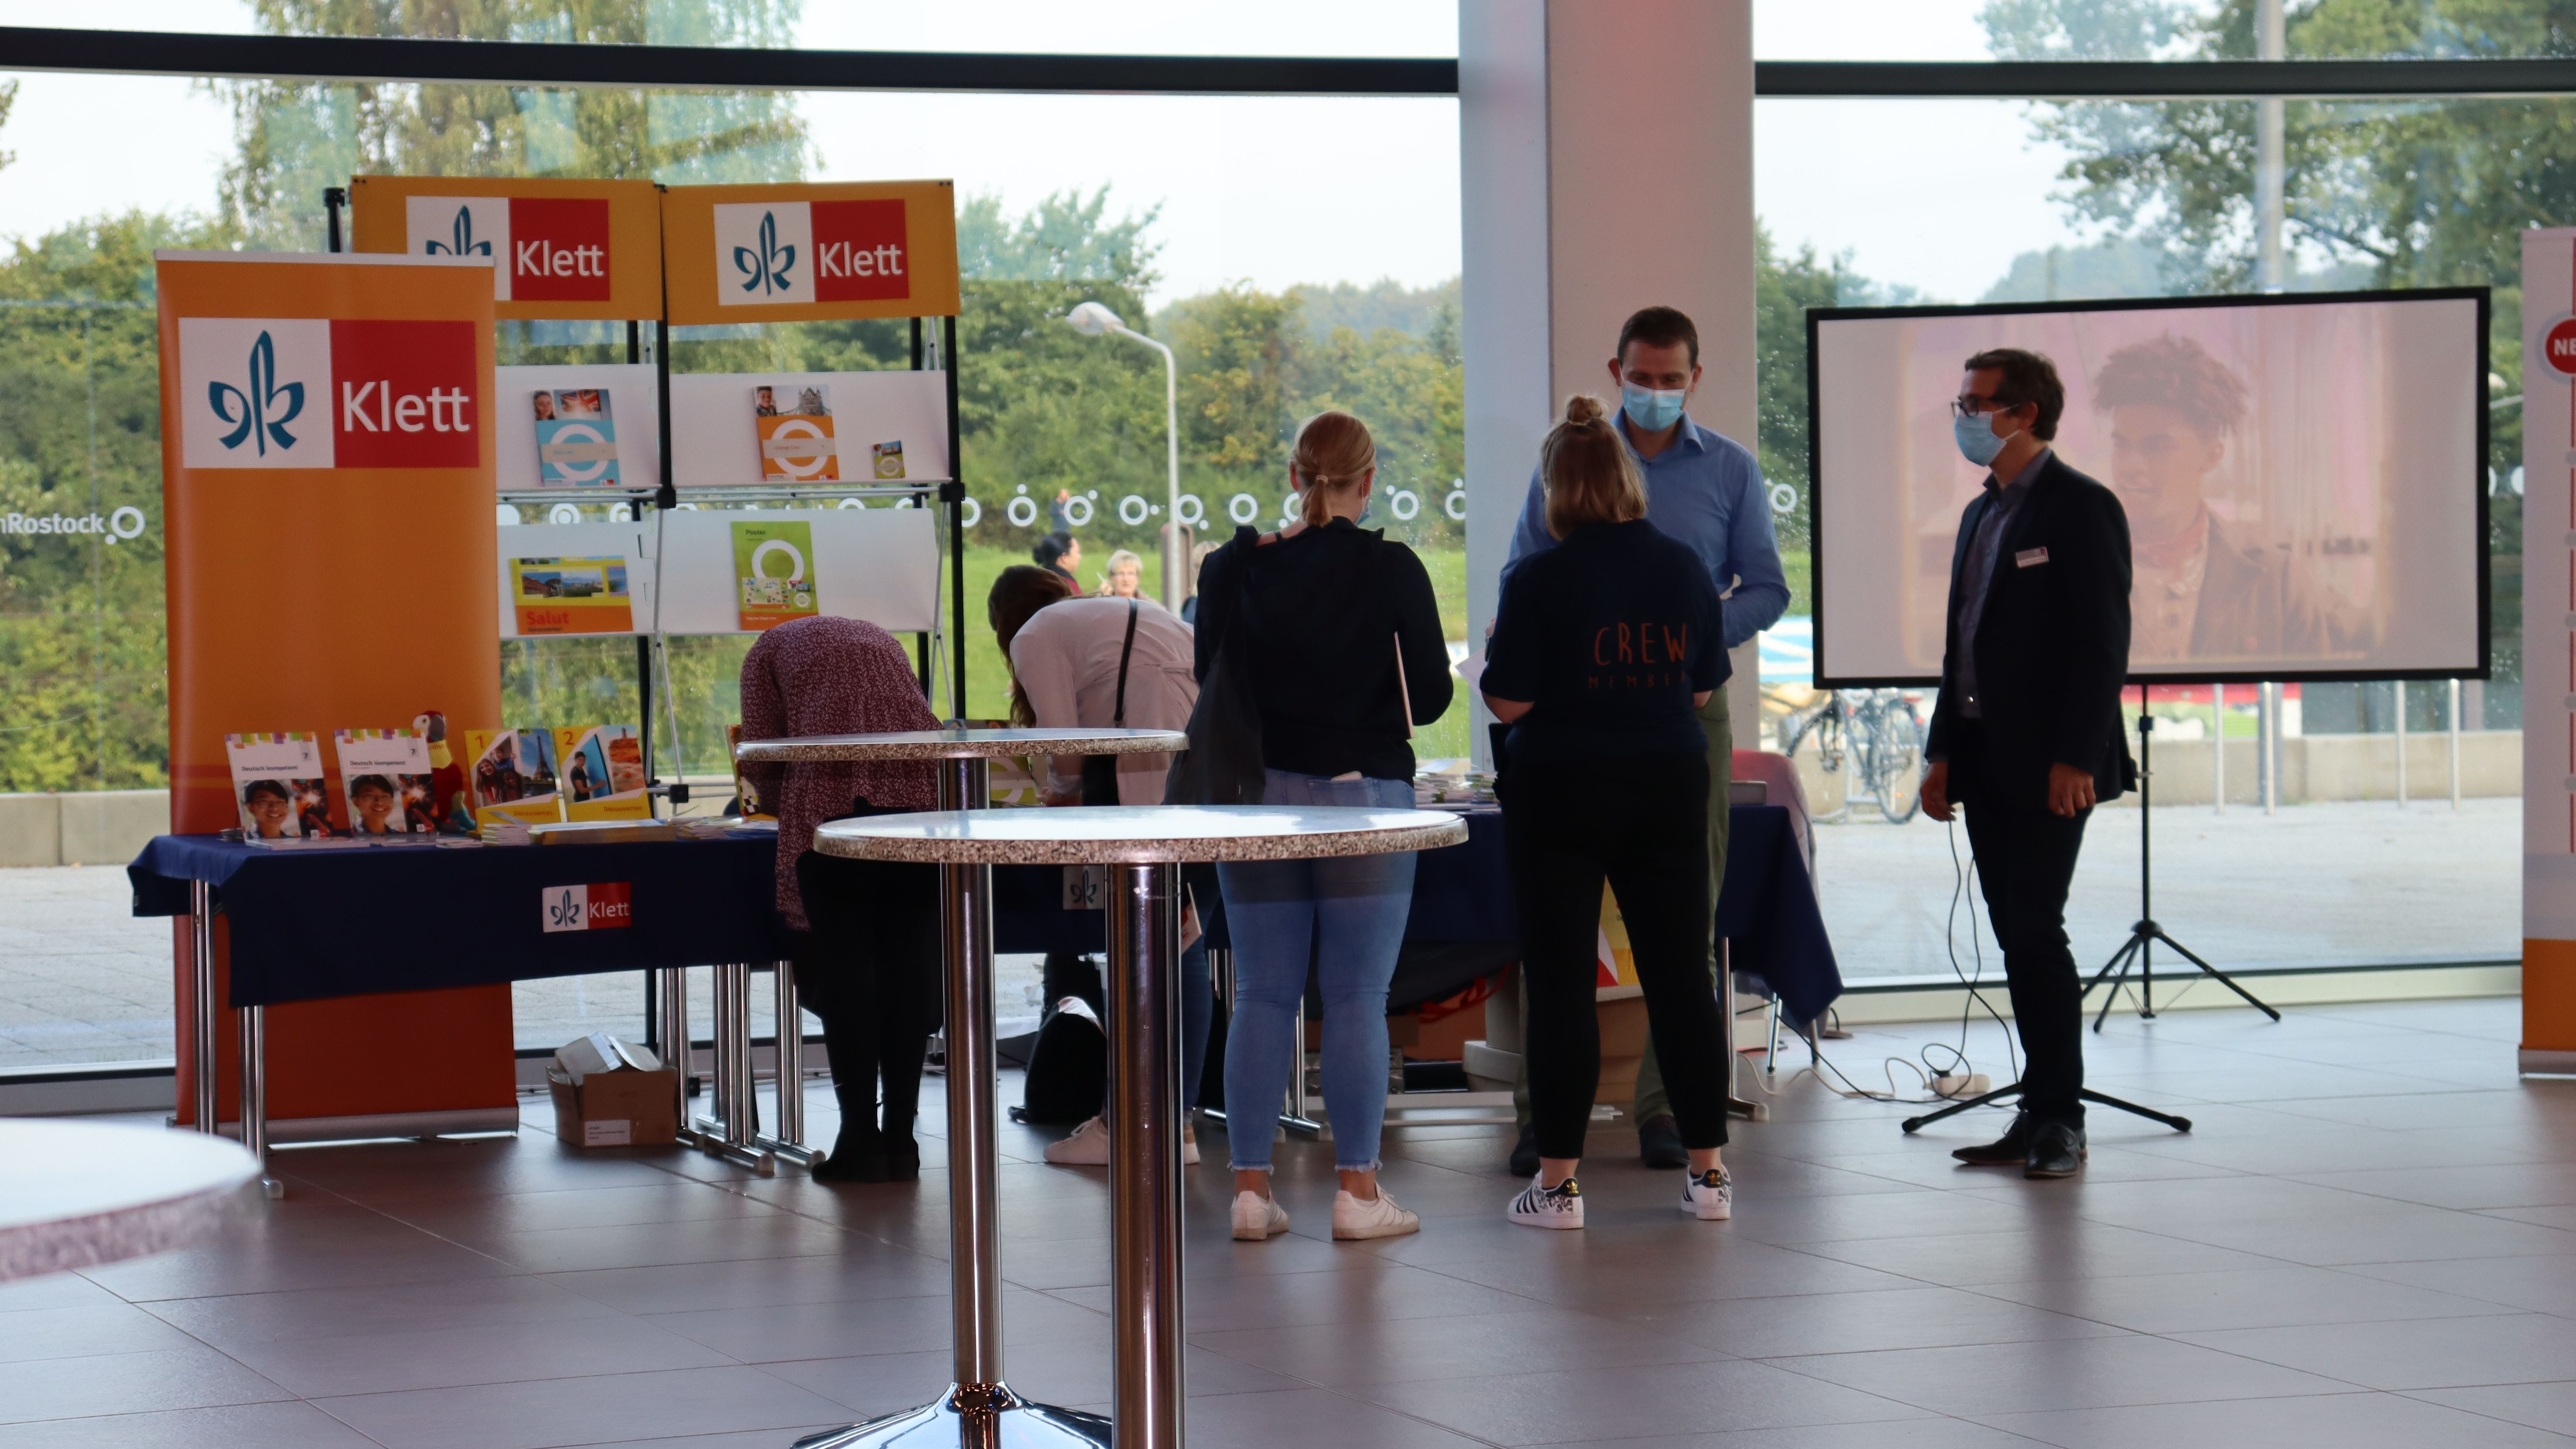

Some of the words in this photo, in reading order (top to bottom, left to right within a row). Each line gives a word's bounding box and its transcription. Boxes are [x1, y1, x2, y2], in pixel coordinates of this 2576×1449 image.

[516, 239, 604, 277] Klett
[818, 241, 902, 277] Klett
[342, 379, 471, 433] Klett
[526, 611, 569, 625] Salut
[1594, 622, 1687, 666] CREW
[475, 735, 485, 749] 1
[563, 731, 575, 746] 2
[589, 901, 629, 919] Klett
